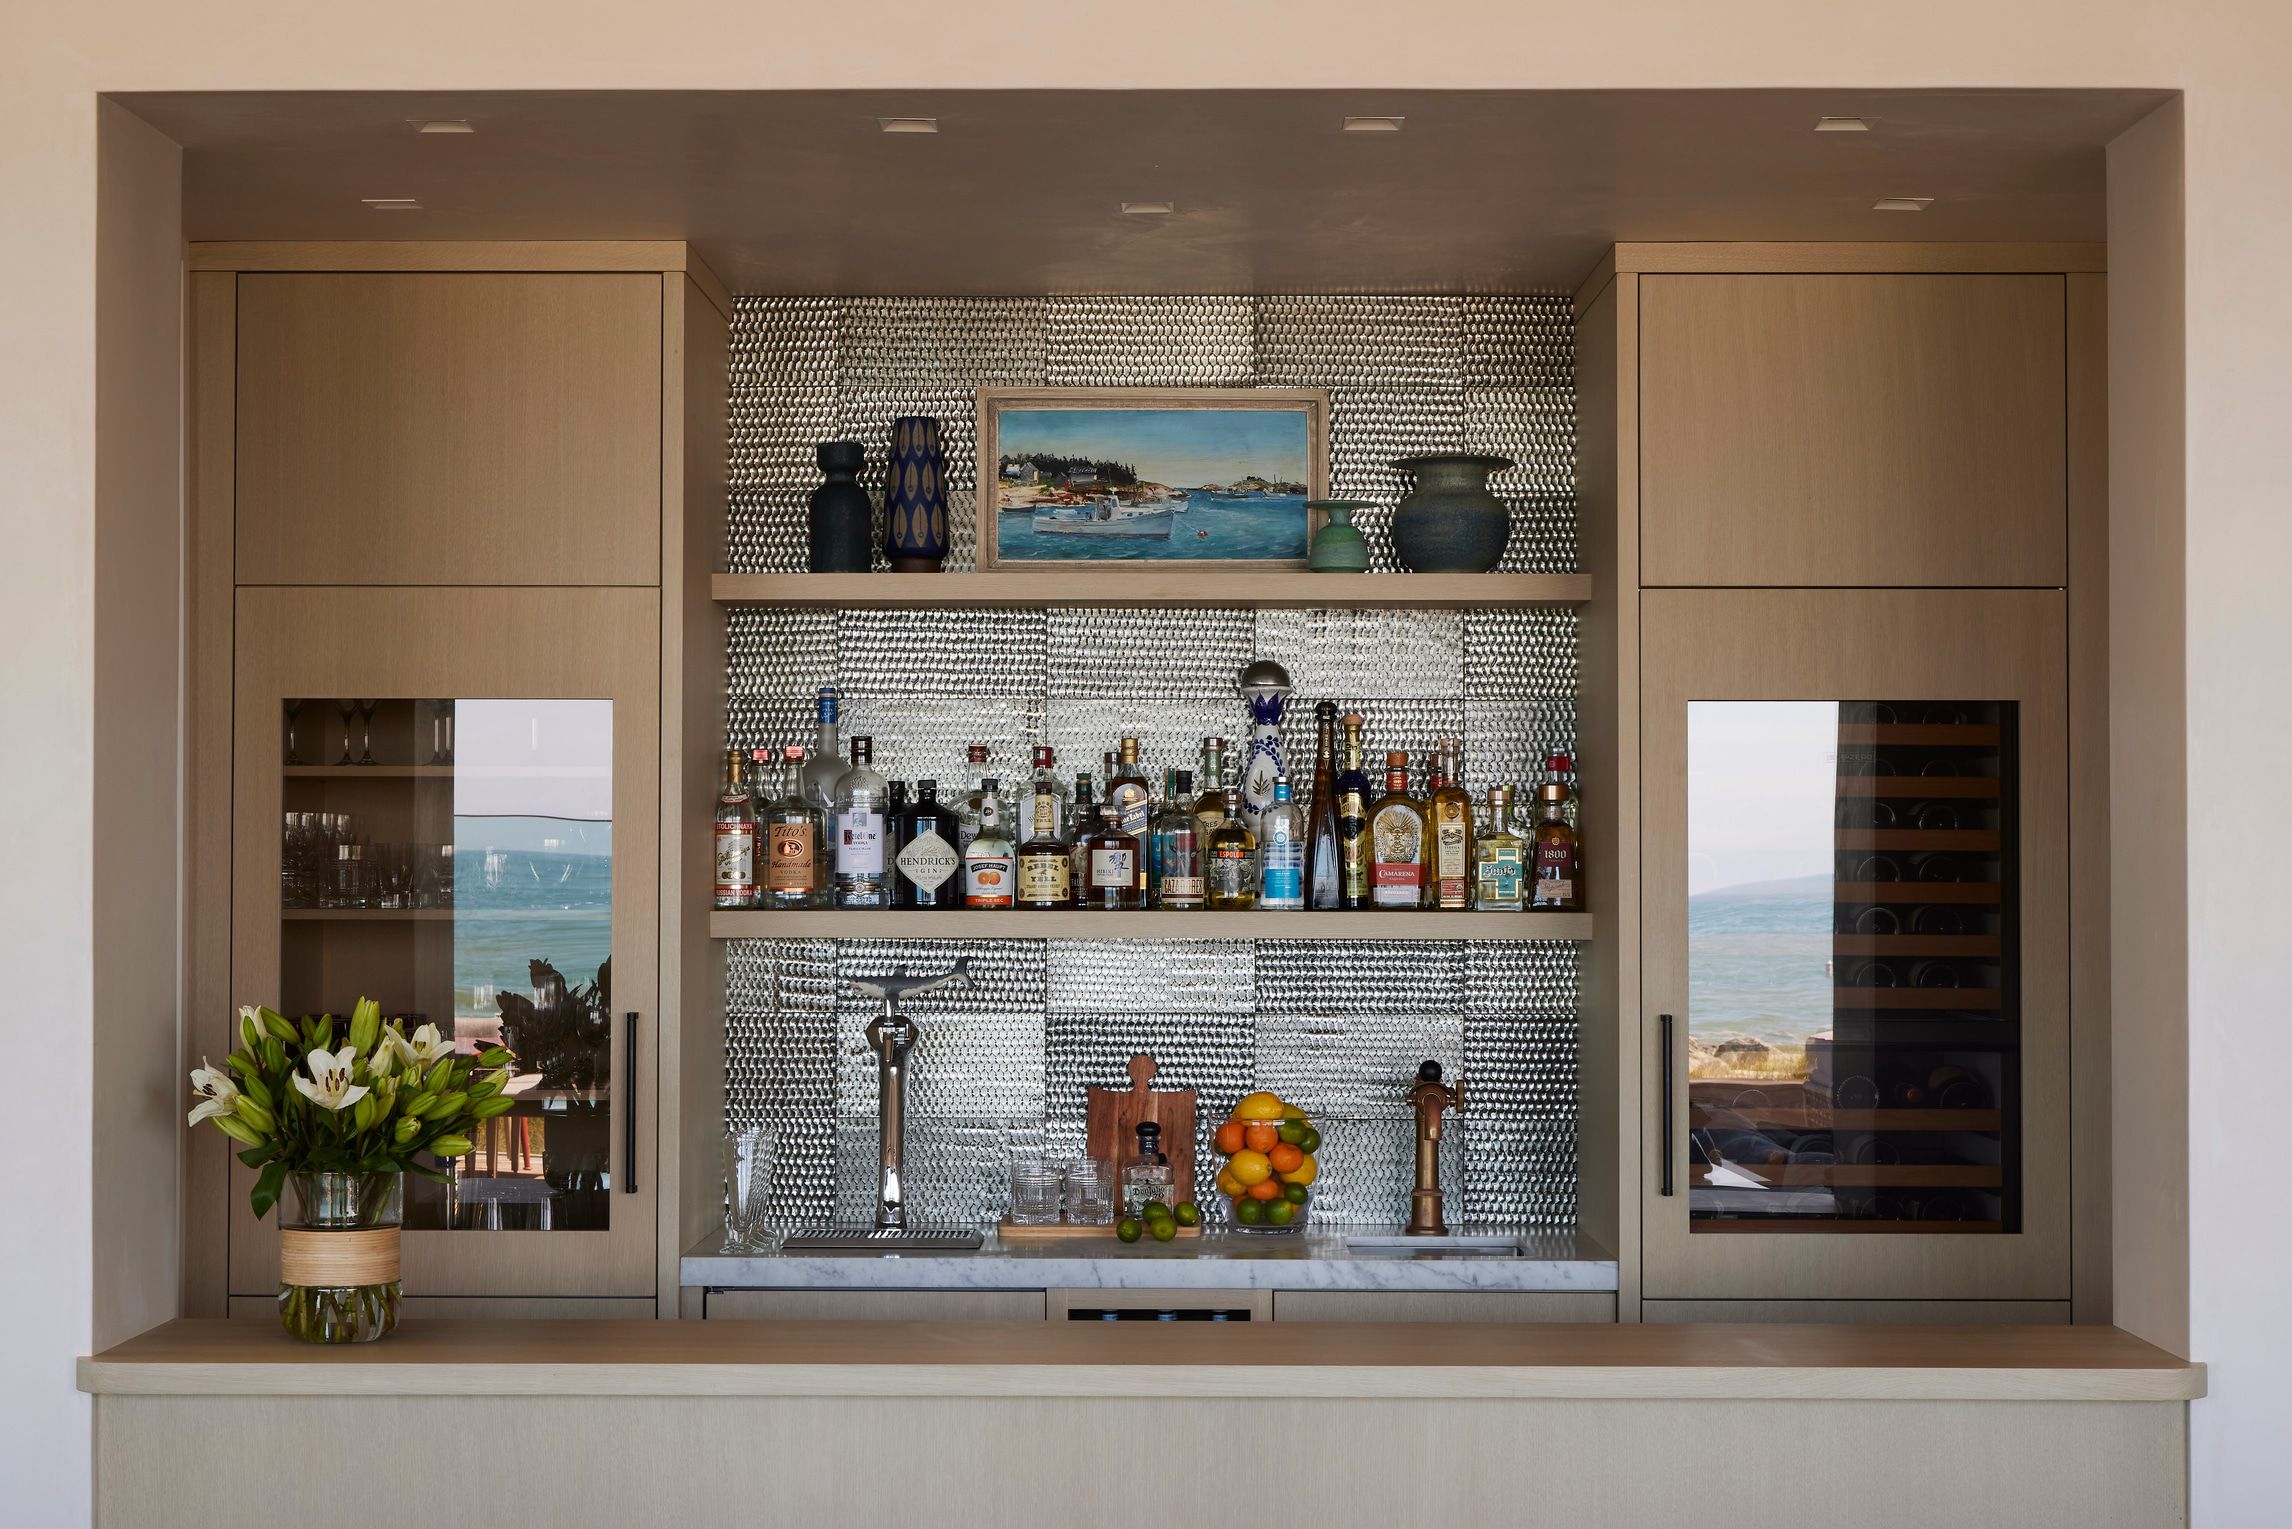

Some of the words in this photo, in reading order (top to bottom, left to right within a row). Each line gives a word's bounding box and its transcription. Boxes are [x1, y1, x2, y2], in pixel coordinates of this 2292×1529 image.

[1129, 810, 1145, 820] Label
[774, 825, 808, 837] Tito's
[1544, 850, 1567, 859] 1800
[771, 859, 812, 868] Handmade
[900, 857, 956, 865] HENDRICK'S
[988, 863, 1007, 871] HAUPT
[1027, 863, 1060, 872] REBEL
[1378, 869, 1416, 879] CAMARENA
[1164, 879, 1203, 893] CAZARES
